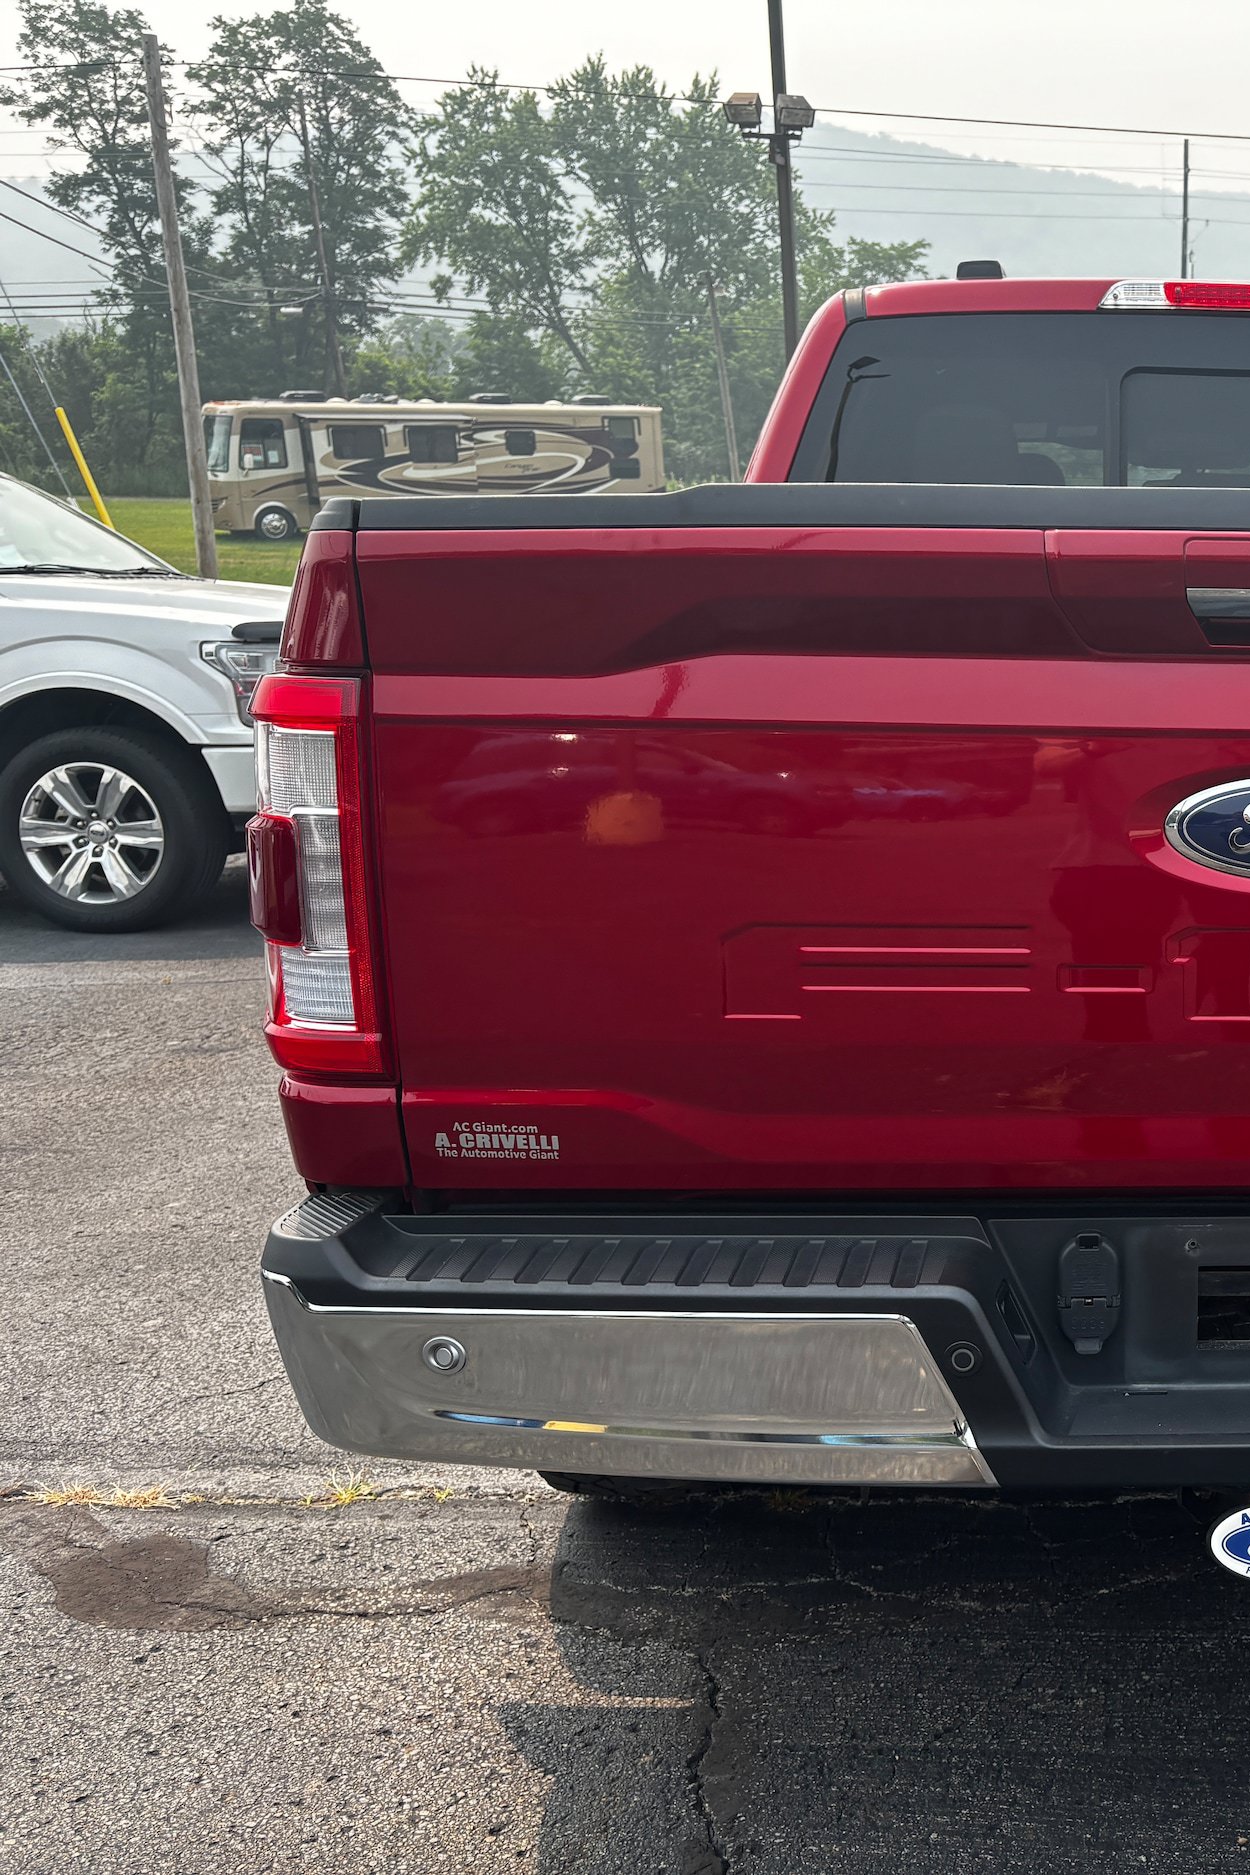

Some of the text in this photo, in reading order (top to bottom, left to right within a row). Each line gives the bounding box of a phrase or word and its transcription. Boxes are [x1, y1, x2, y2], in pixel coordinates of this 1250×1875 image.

[453, 1122, 538, 1133] AC Giant.com
[435, 1132, 560, 1150] A. CRIVELLI
[437, 1148, 559, 1160] The Automotive Giant
